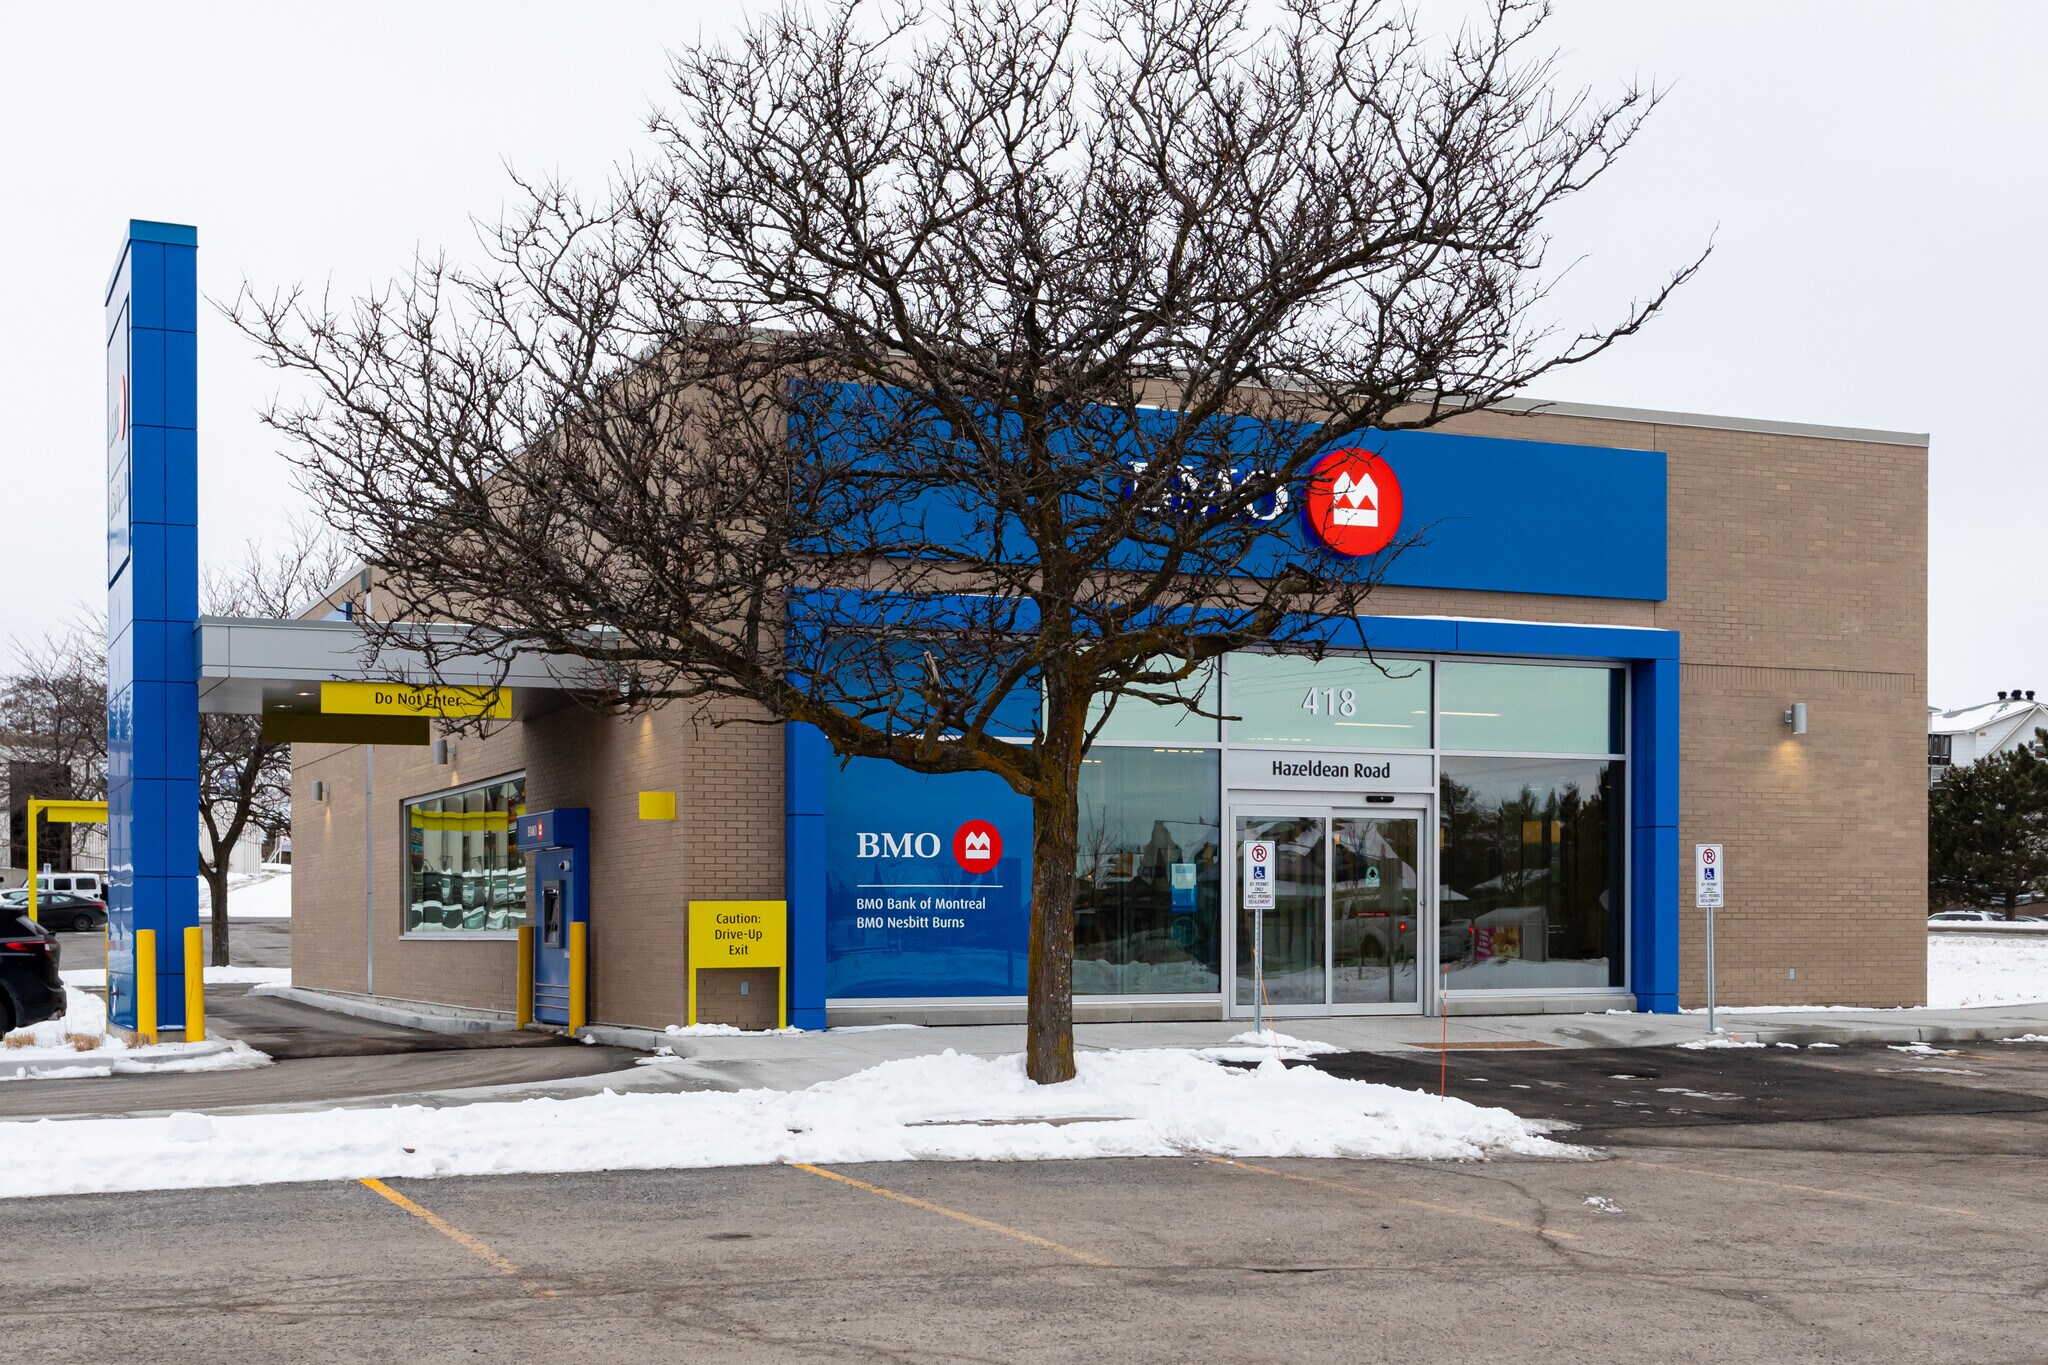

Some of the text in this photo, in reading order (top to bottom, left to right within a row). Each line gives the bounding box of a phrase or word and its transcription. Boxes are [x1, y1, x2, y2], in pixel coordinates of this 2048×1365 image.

[375, 691, 462, 707] Do Not Enter
[1301, 686, 1357, 717] 418
[1272, 760, 1391, 779] Hazeldean Road
[856, 832, 941, 859] BMO
[856, 897, 986, 910] BMO Bank of Montreal
[716, 913, 761, 924] Caution:
[856, 915, 965, 929] BMO Nesbitt Burns
[715, 929, 763, 942] Drive-Up
[729, 944, 749, 955] Exit
